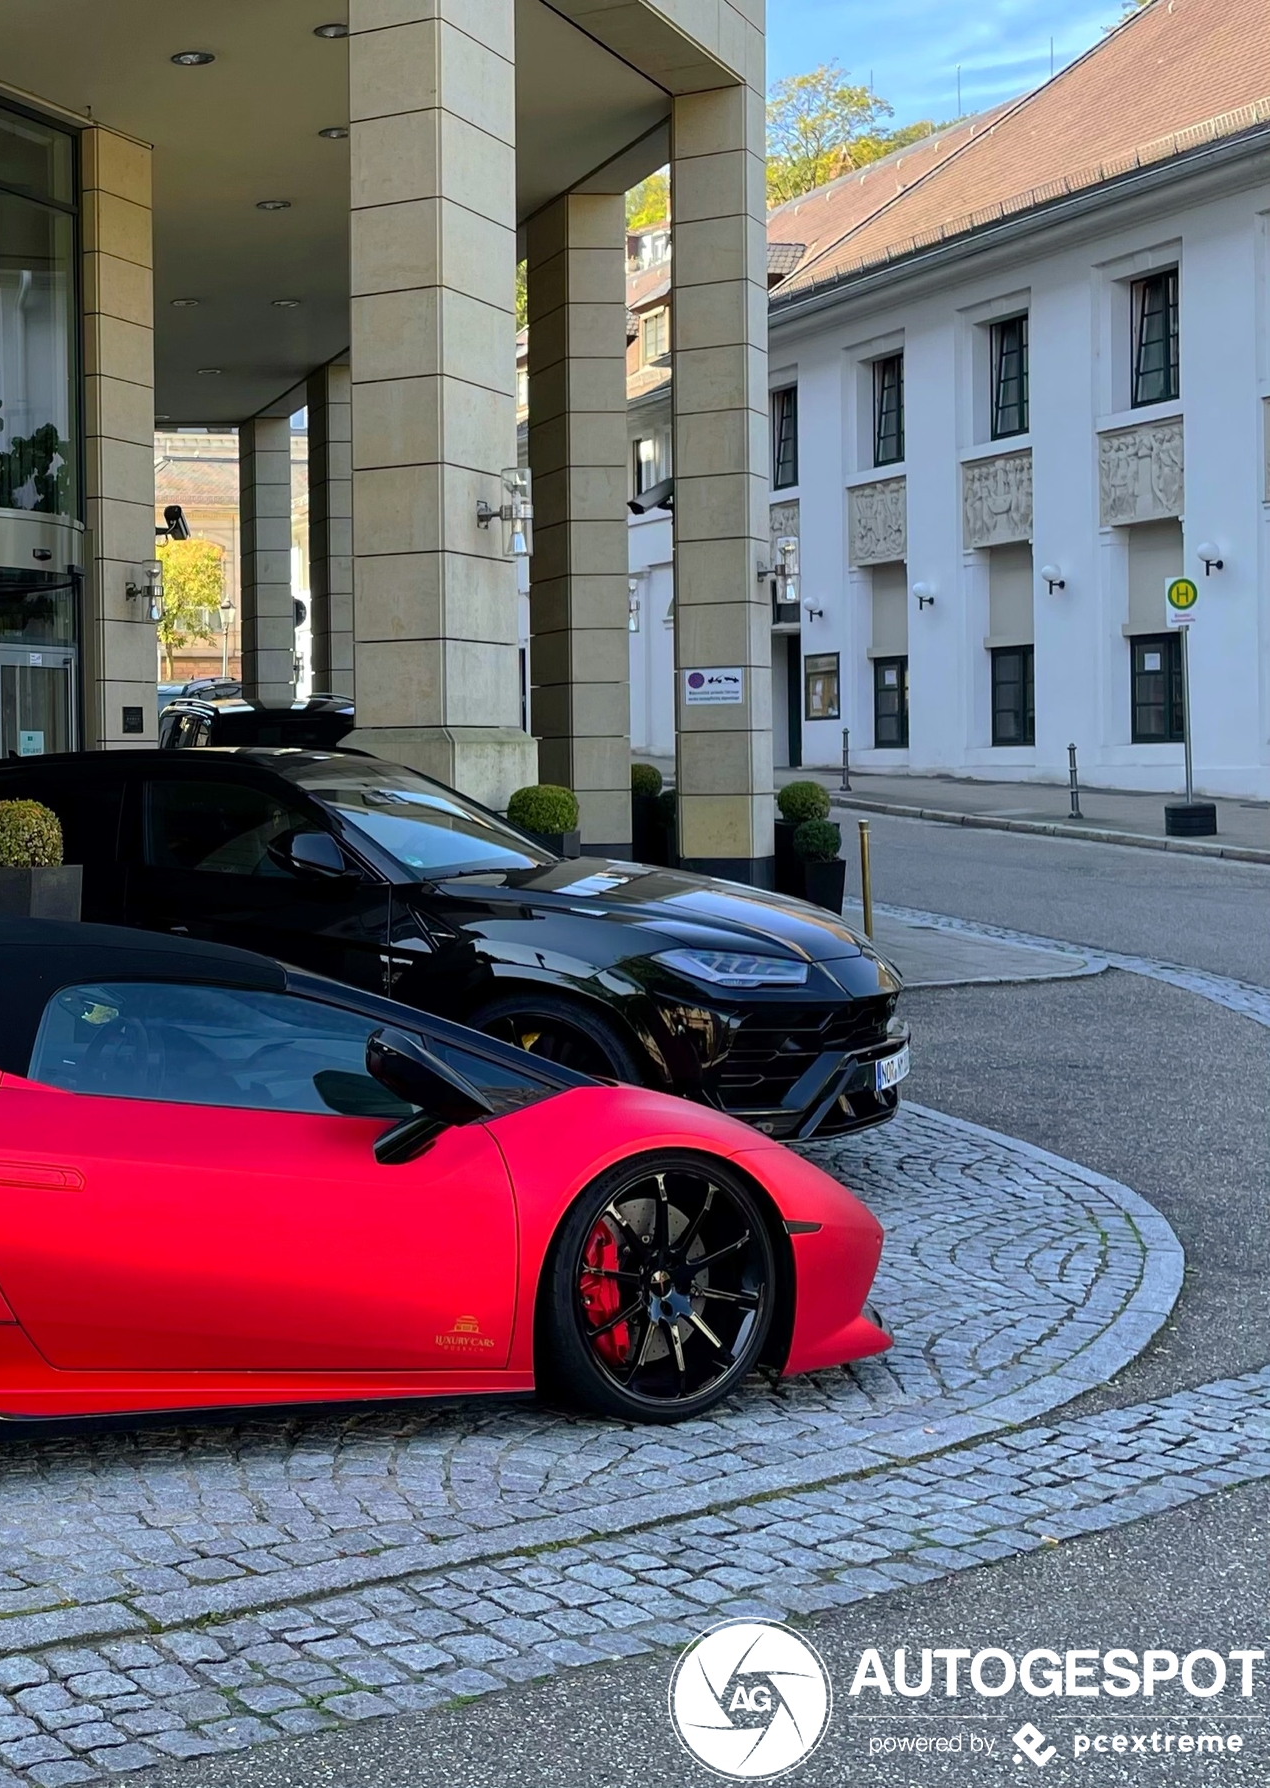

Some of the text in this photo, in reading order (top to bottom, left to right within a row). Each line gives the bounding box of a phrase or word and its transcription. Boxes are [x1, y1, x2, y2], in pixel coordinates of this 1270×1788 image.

[1176, 586, 1189, 603] H
[435, 1335, 495, 1347] LUXURY CARS
